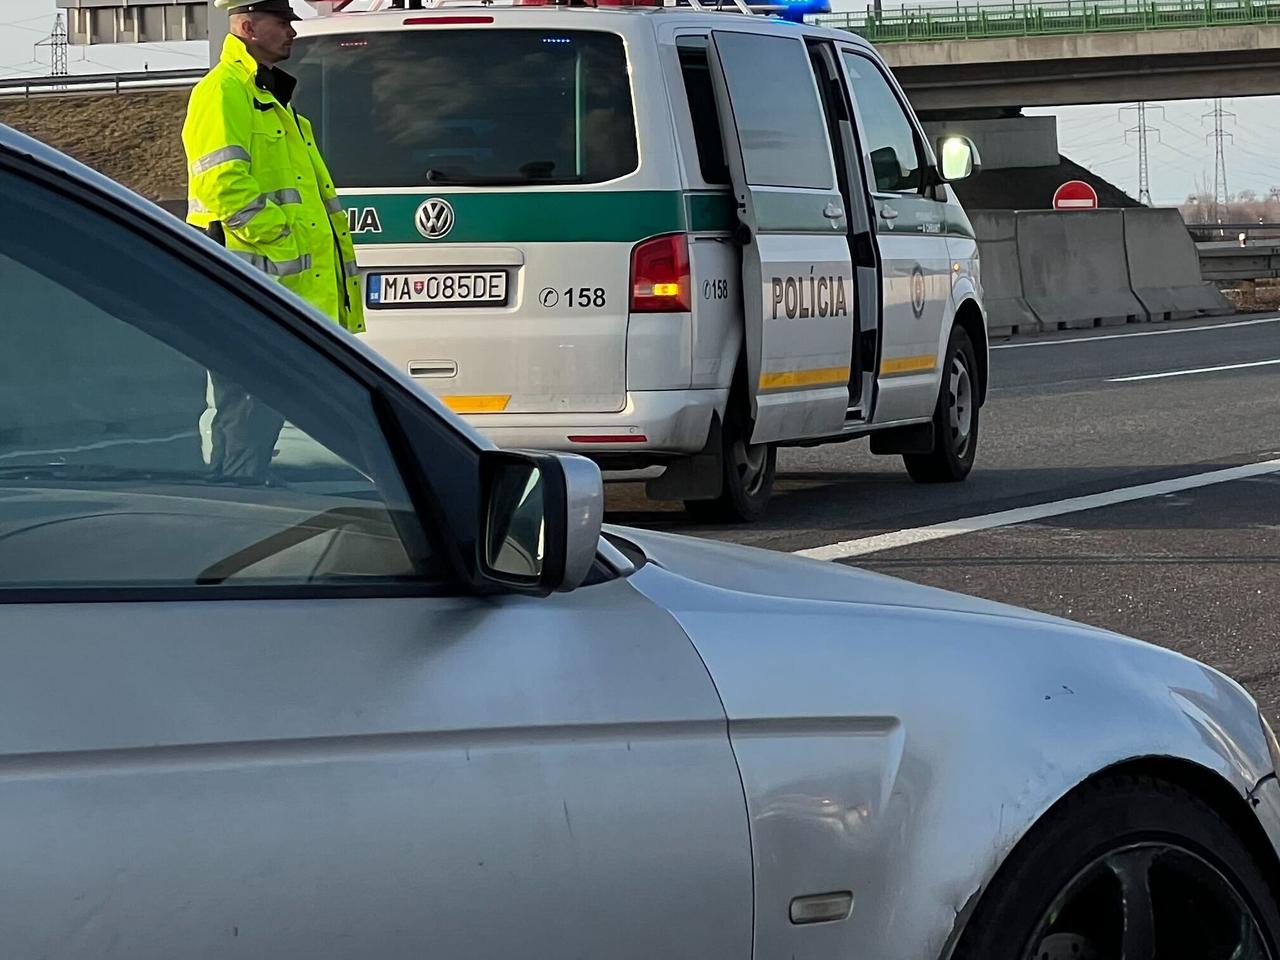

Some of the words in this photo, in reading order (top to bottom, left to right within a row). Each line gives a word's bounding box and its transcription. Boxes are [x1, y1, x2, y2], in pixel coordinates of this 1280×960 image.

[342, 207, 382, 233] IA
[563, 287, 606, 308] 158
[712, 280, 728, 300] 158
[772, 265, 847, 320] POLÍCIA
